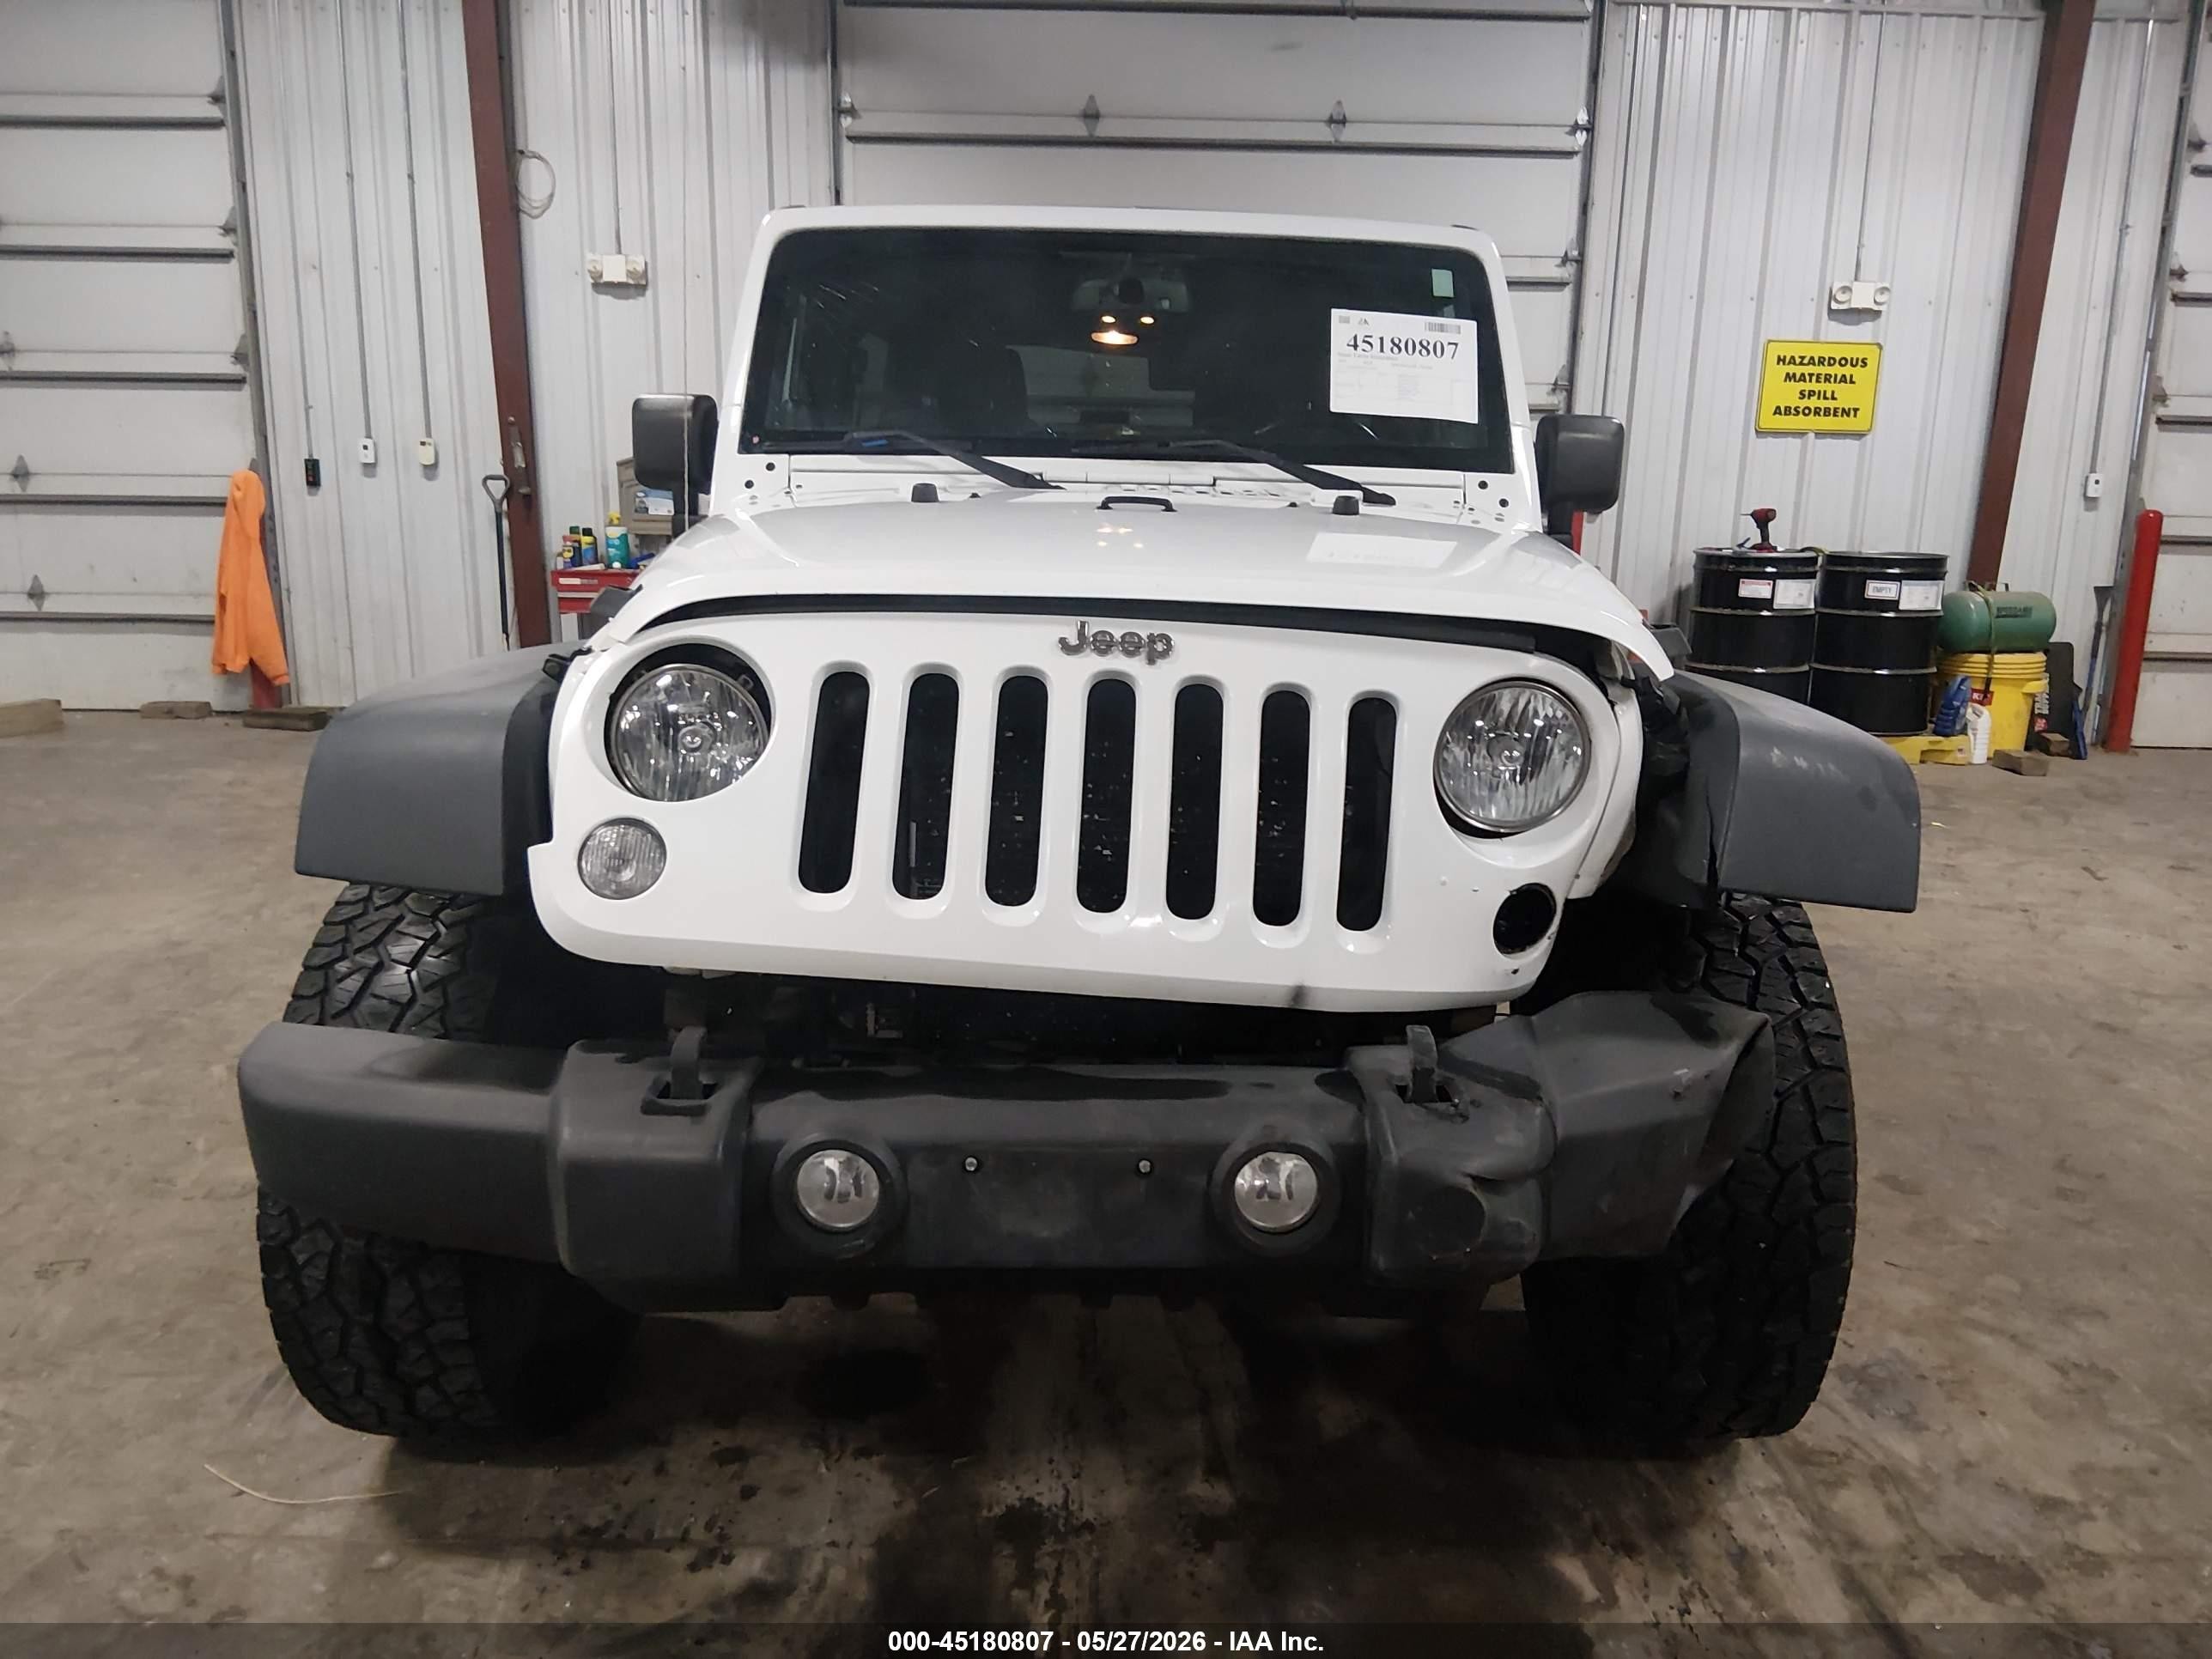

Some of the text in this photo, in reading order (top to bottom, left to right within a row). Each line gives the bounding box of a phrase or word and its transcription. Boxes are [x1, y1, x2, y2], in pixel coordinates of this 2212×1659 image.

[1346, 333, 1459, 360] 45180807
[1776, 354, 1869, 368] HAZARDOUS
[1784, 372, 1856, 385] MATERIAL
[1798, 389, 1838, 400] SPILL
[1772, 405, 1860, 418] ABSORBENT
[1058, 620, 1175, 665] Jeep
